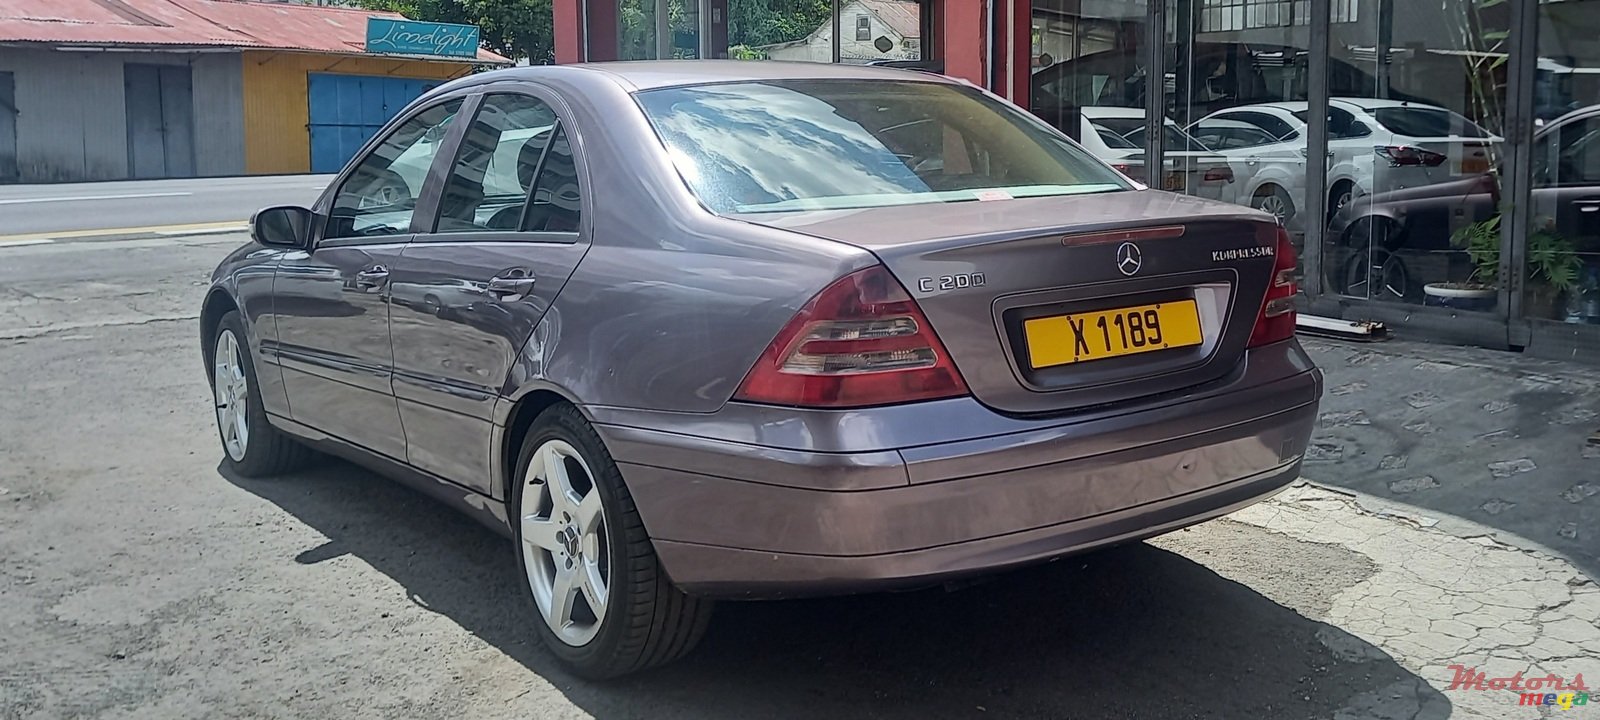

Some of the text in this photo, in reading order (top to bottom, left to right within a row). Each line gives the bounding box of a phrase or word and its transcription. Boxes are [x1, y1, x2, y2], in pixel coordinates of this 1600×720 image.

[370, 21, 477, 54] Limelight
[1212, 246, 1274, 261] KOMPRESSOR
[918, 271, 986, 292] C 200
[1071, 308, 1162, 357] X 1189
